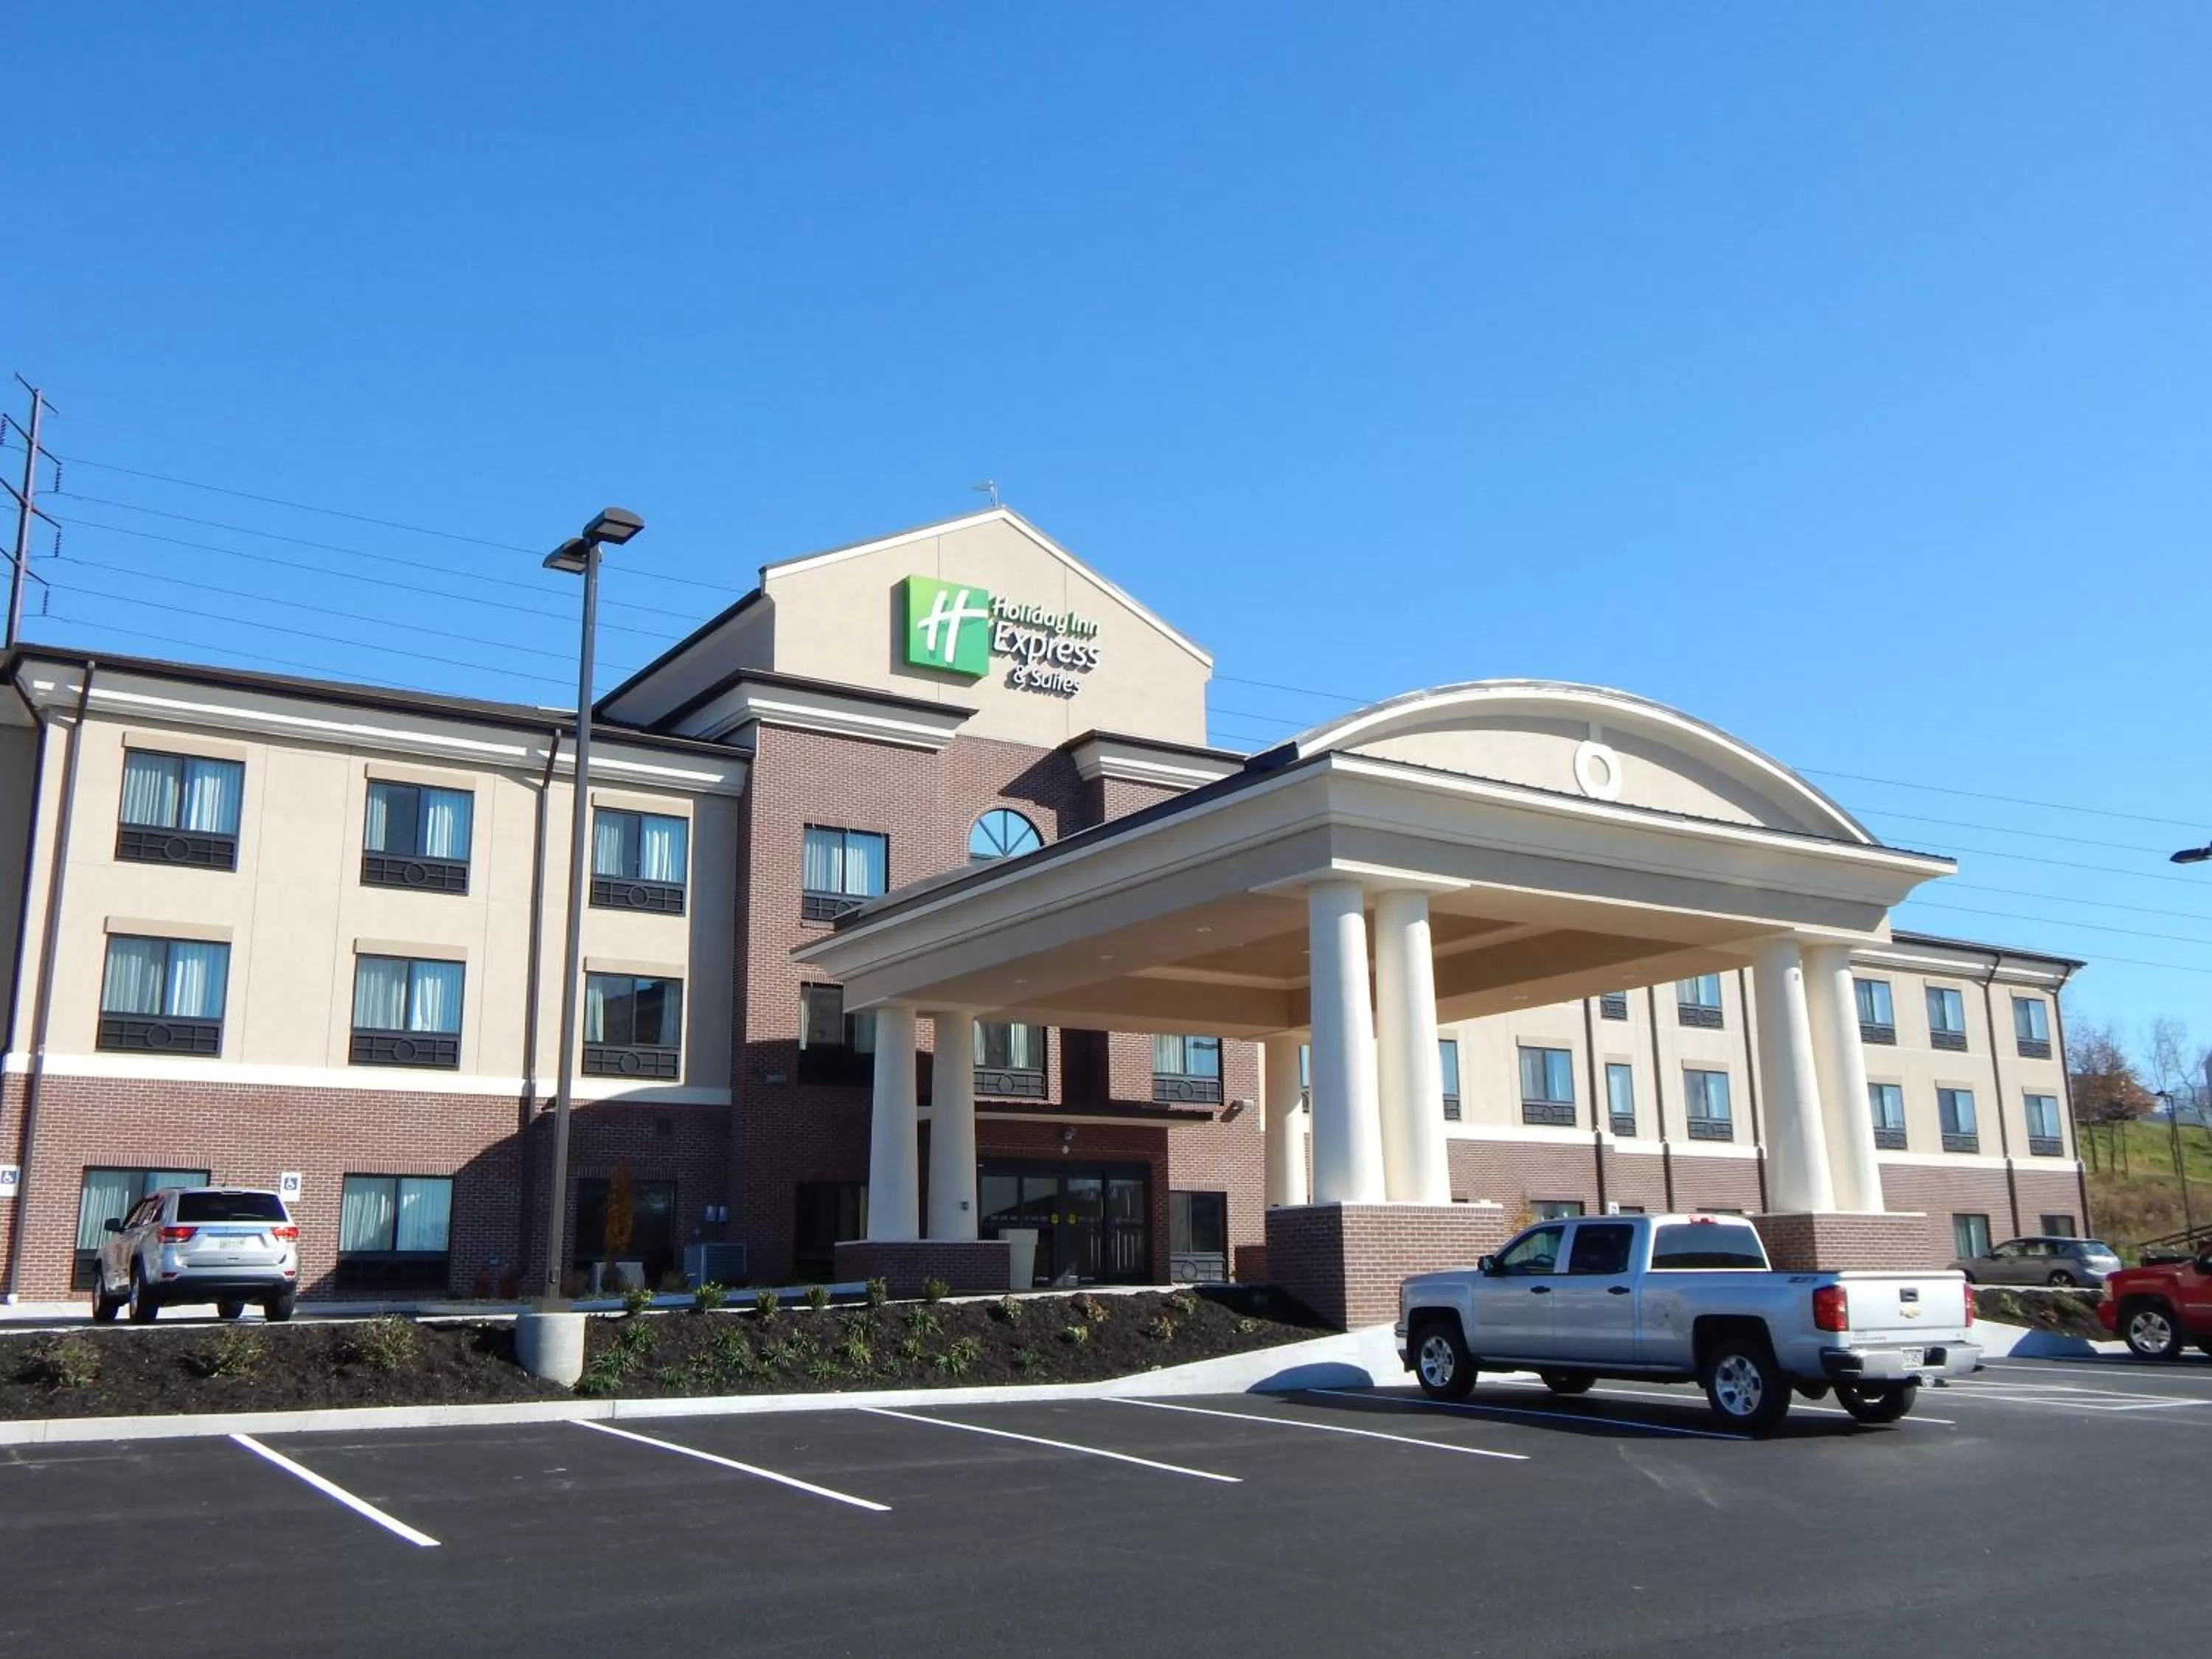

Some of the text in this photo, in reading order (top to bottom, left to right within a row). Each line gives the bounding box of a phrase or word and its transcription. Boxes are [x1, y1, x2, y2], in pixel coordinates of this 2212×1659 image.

[917, 589, 989, 664] H
[992, 595, 1101, 636] Holiday Inn
[993, 620, 1101, 668] Express
[1013, 664, 1082, 695] & Suites
